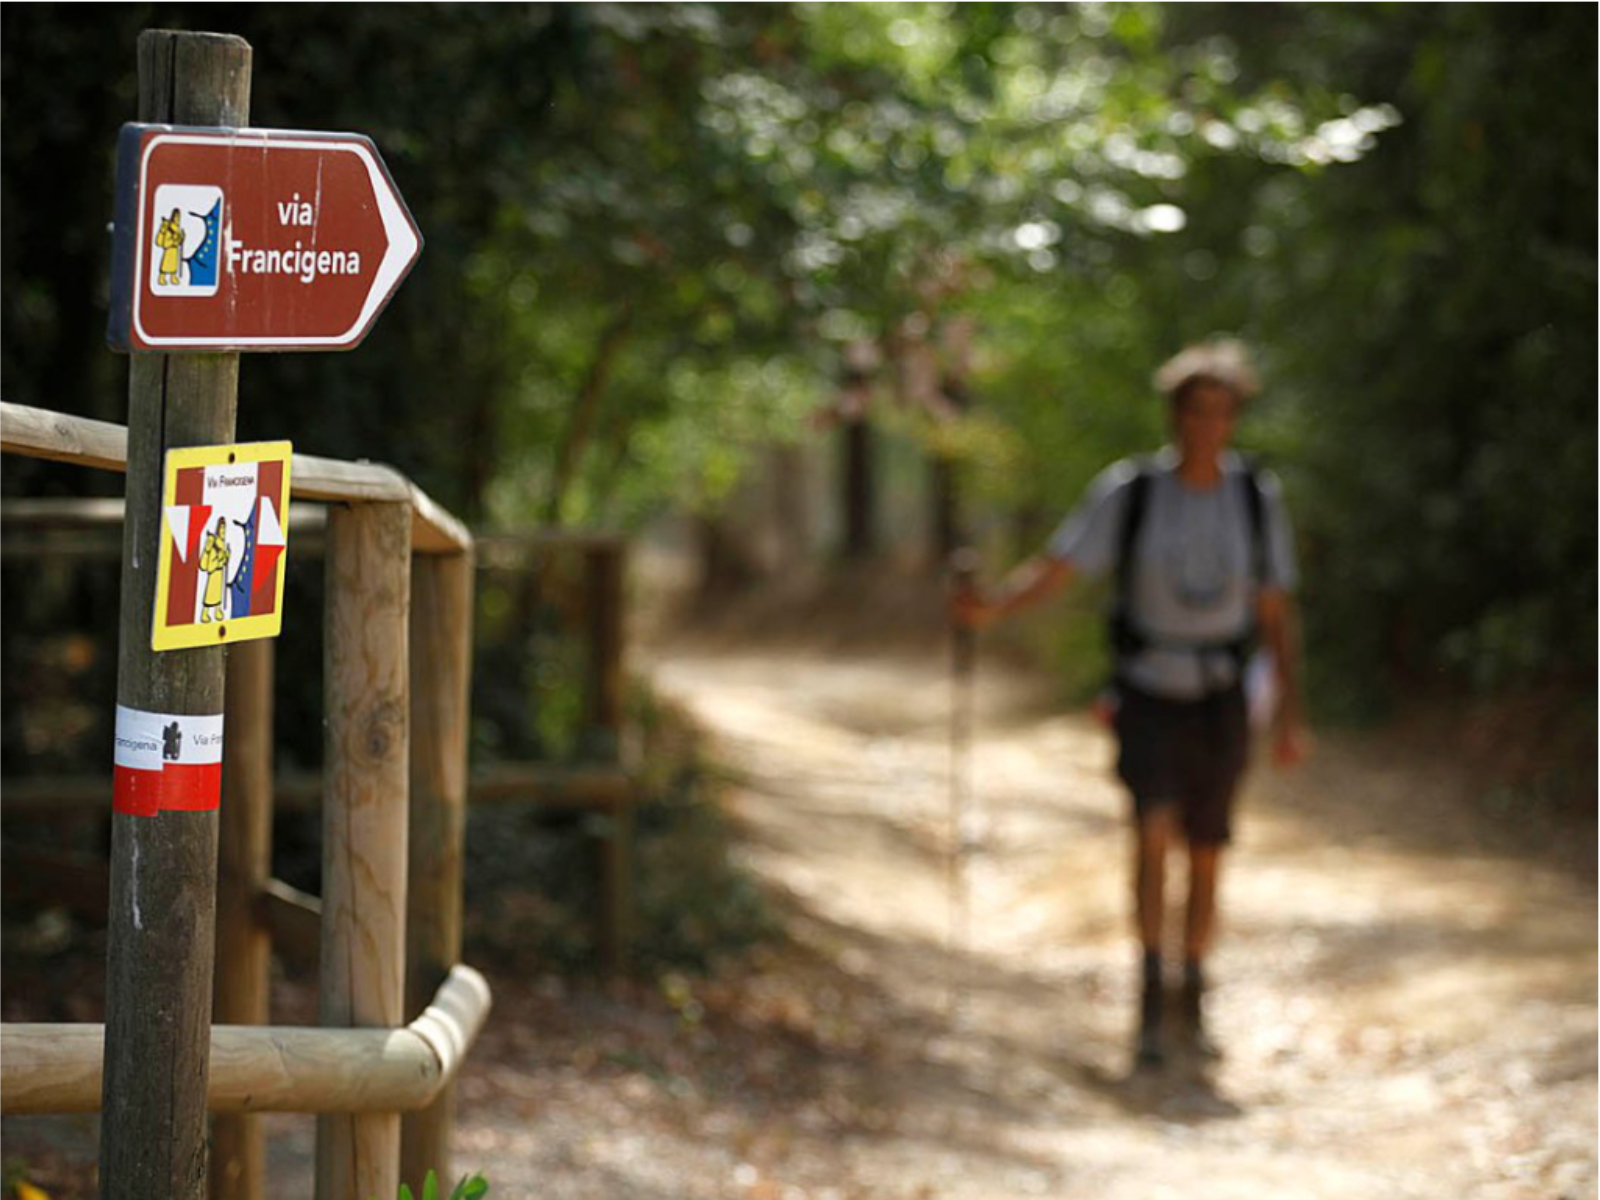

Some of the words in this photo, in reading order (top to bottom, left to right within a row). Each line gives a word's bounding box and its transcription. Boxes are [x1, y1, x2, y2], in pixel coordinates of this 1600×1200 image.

[277, 192, 313, 226] via
[226, 240, 360, 283] Francigena
[193, 734, 209, 746] Via
